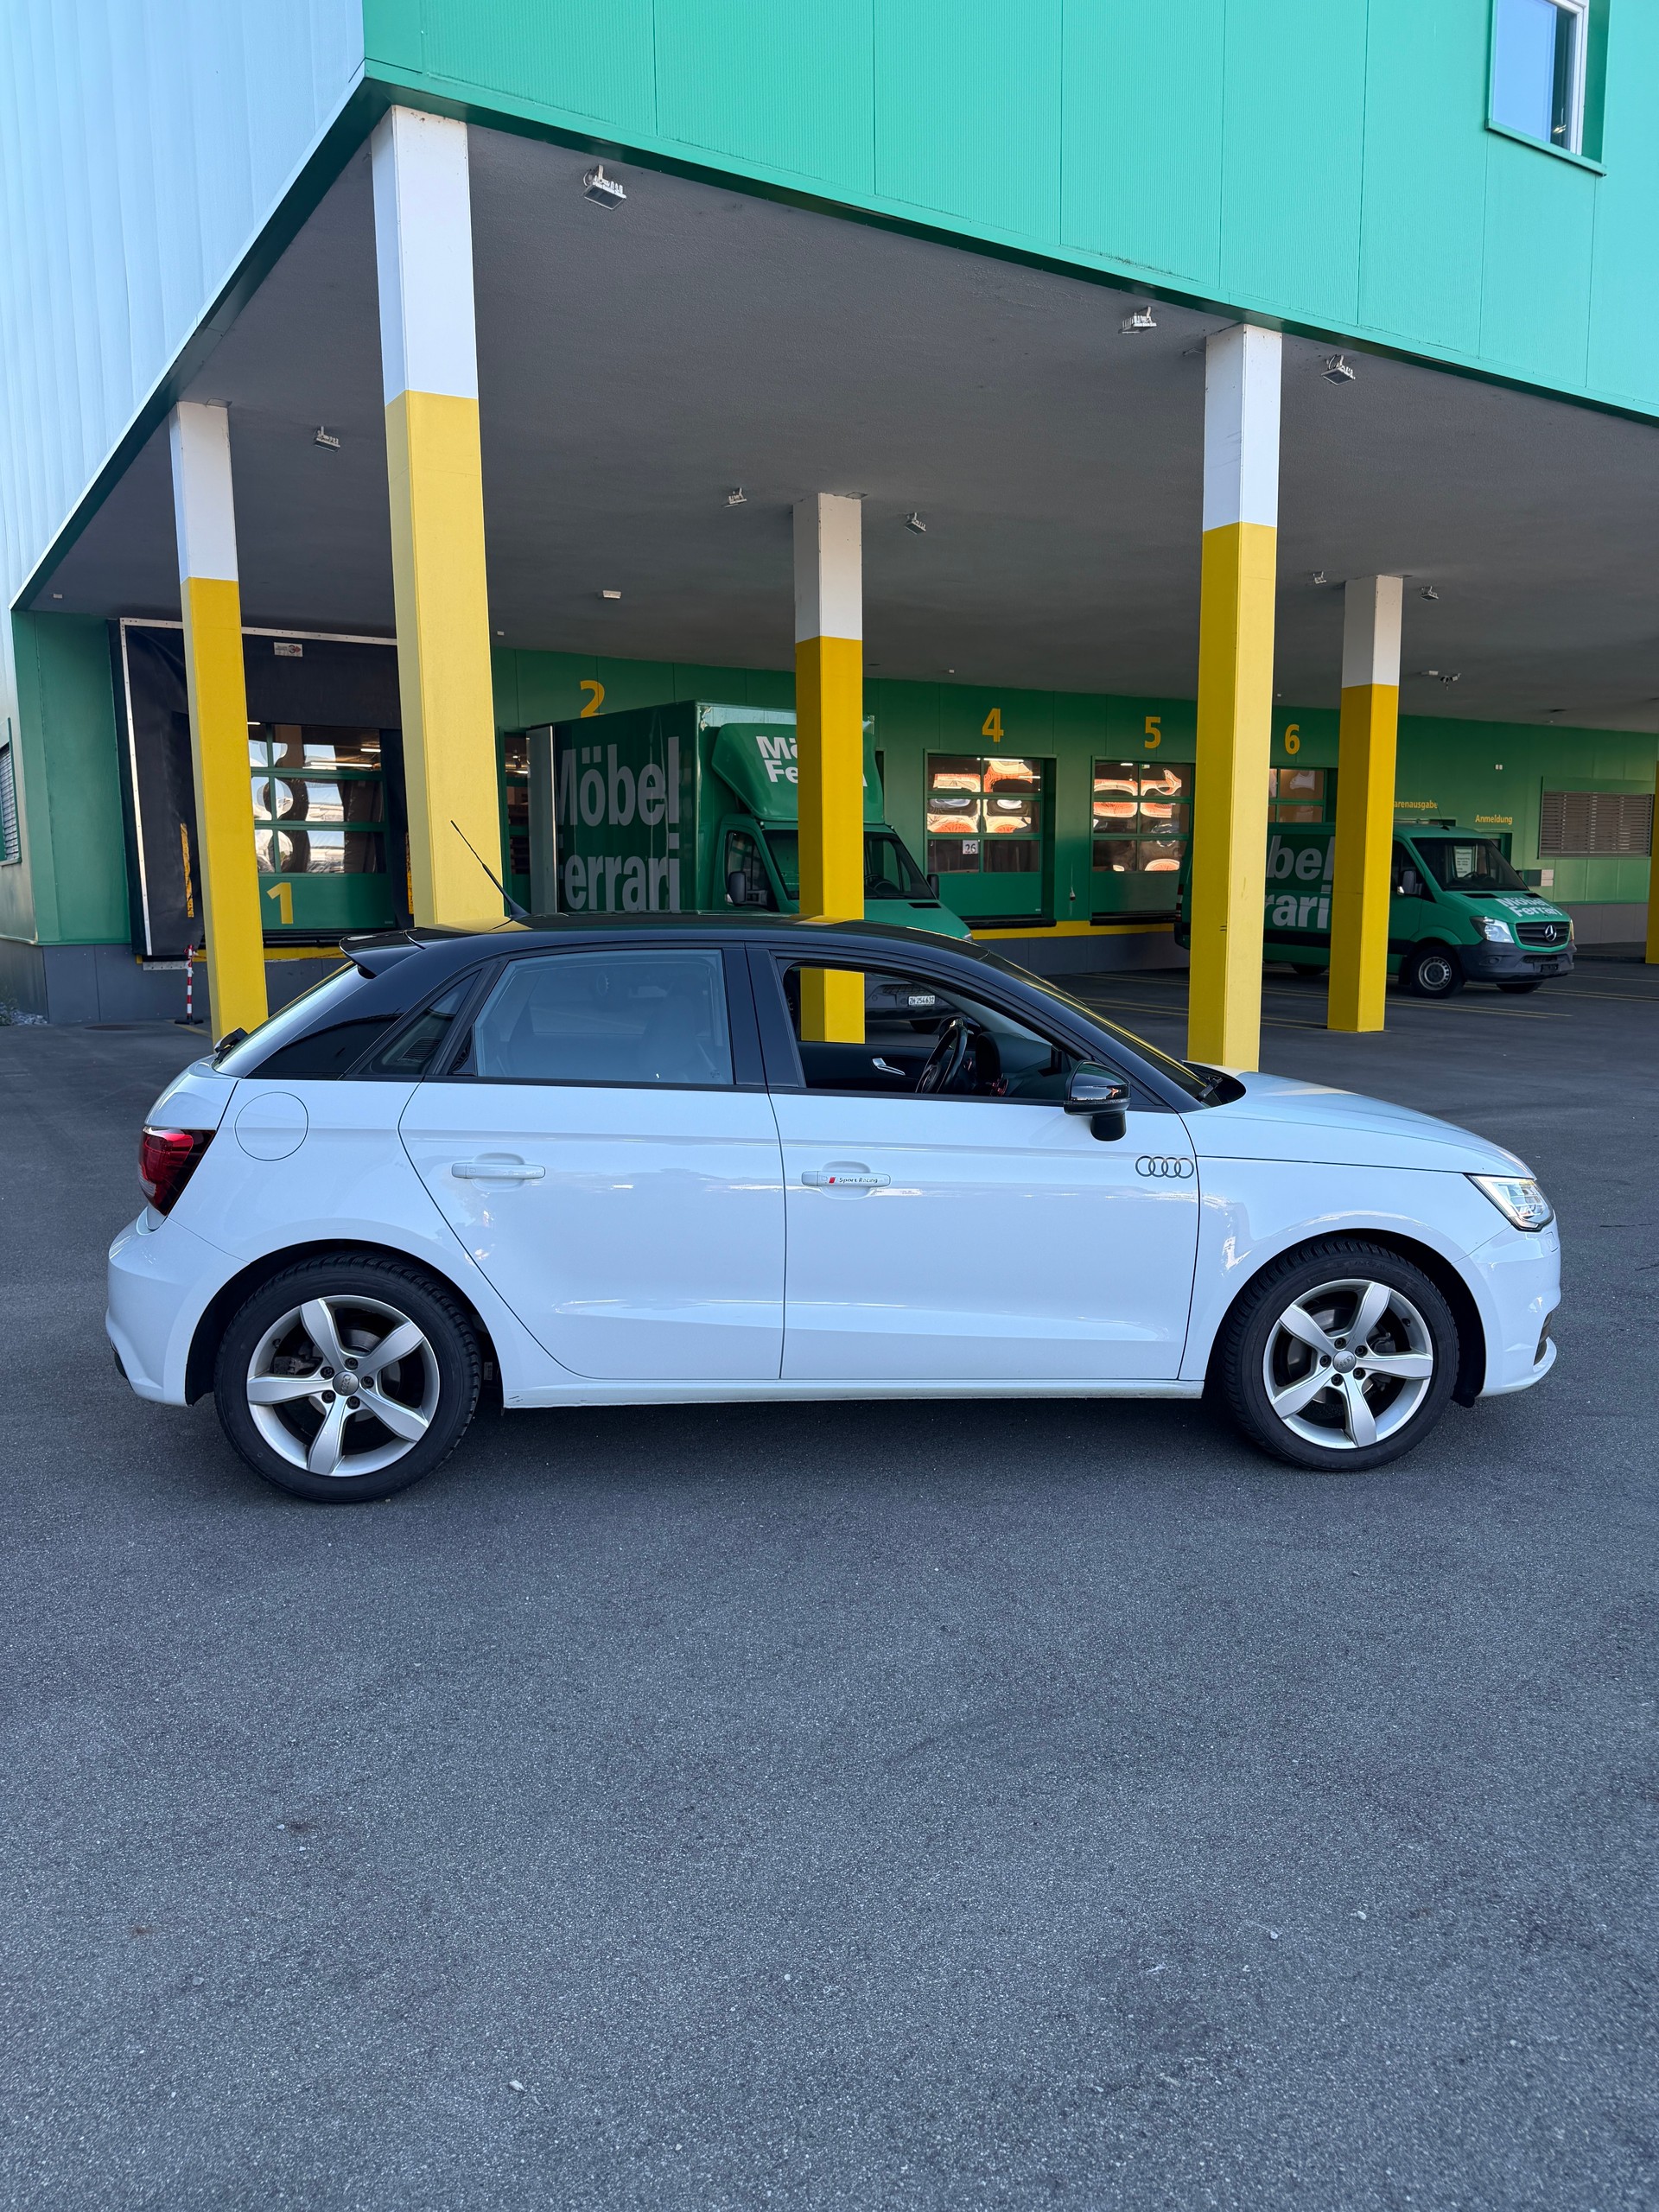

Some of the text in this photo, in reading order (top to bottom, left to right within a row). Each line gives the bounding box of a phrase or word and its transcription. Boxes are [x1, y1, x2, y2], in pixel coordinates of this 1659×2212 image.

[580, 679, 606, 718] 2
[982, 708, 1004, 742] 4
[1144, 716, 1161, 749] 5
[1285, 723, 1300, 755] 6
[1393, 800, 1439, 810] arenausgabe
[1475, 814, 1513, 825] Anmeldung
[965, 843, 976, 853] 26
[1266, 835, 1336, 880] bel
[557, 832, 681, 913] errari
[266, 881, 294, 925] 1
[1495, 898, 1554, 909] Möbel
[1509, 906, 1563, 918] Ferrari
